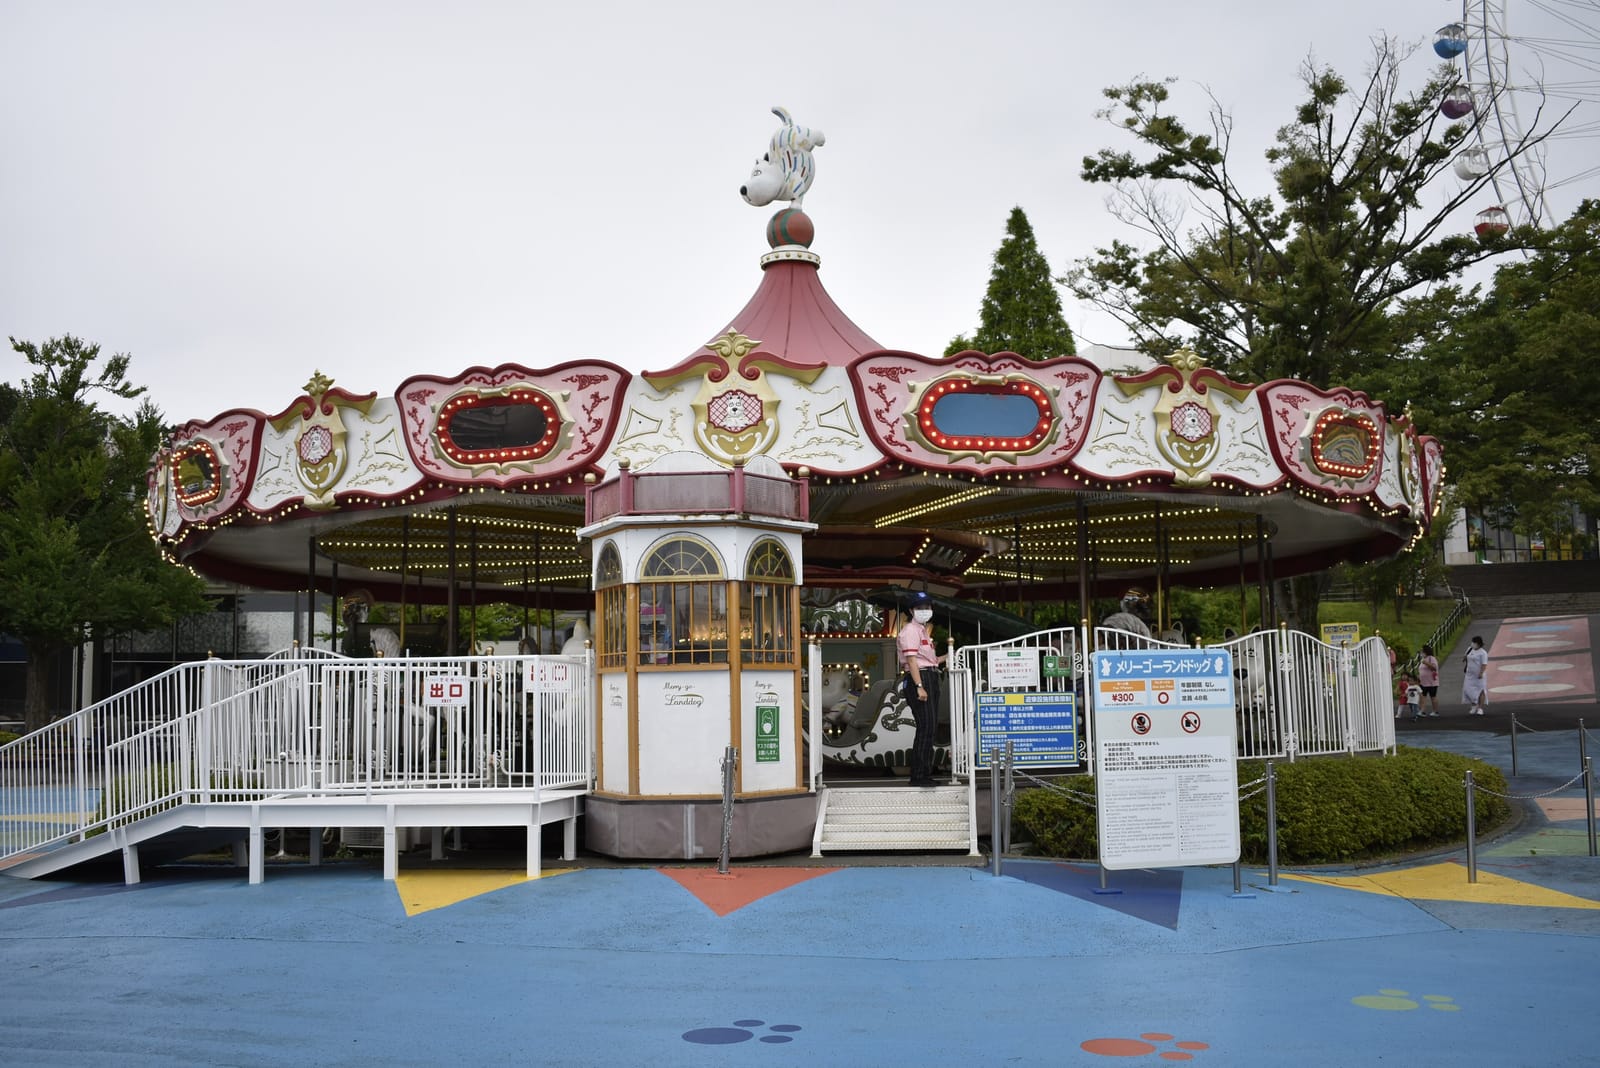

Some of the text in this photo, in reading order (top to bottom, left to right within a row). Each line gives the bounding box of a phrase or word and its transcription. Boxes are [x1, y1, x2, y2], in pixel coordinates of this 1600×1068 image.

[1116, 660, 1211, 674] メリーゴーランドドッグ
[430, 683, 462, 698] 出口
[1112, 693, 1134, 702] ¥300
[664, 693, 704, 708] Landdog
